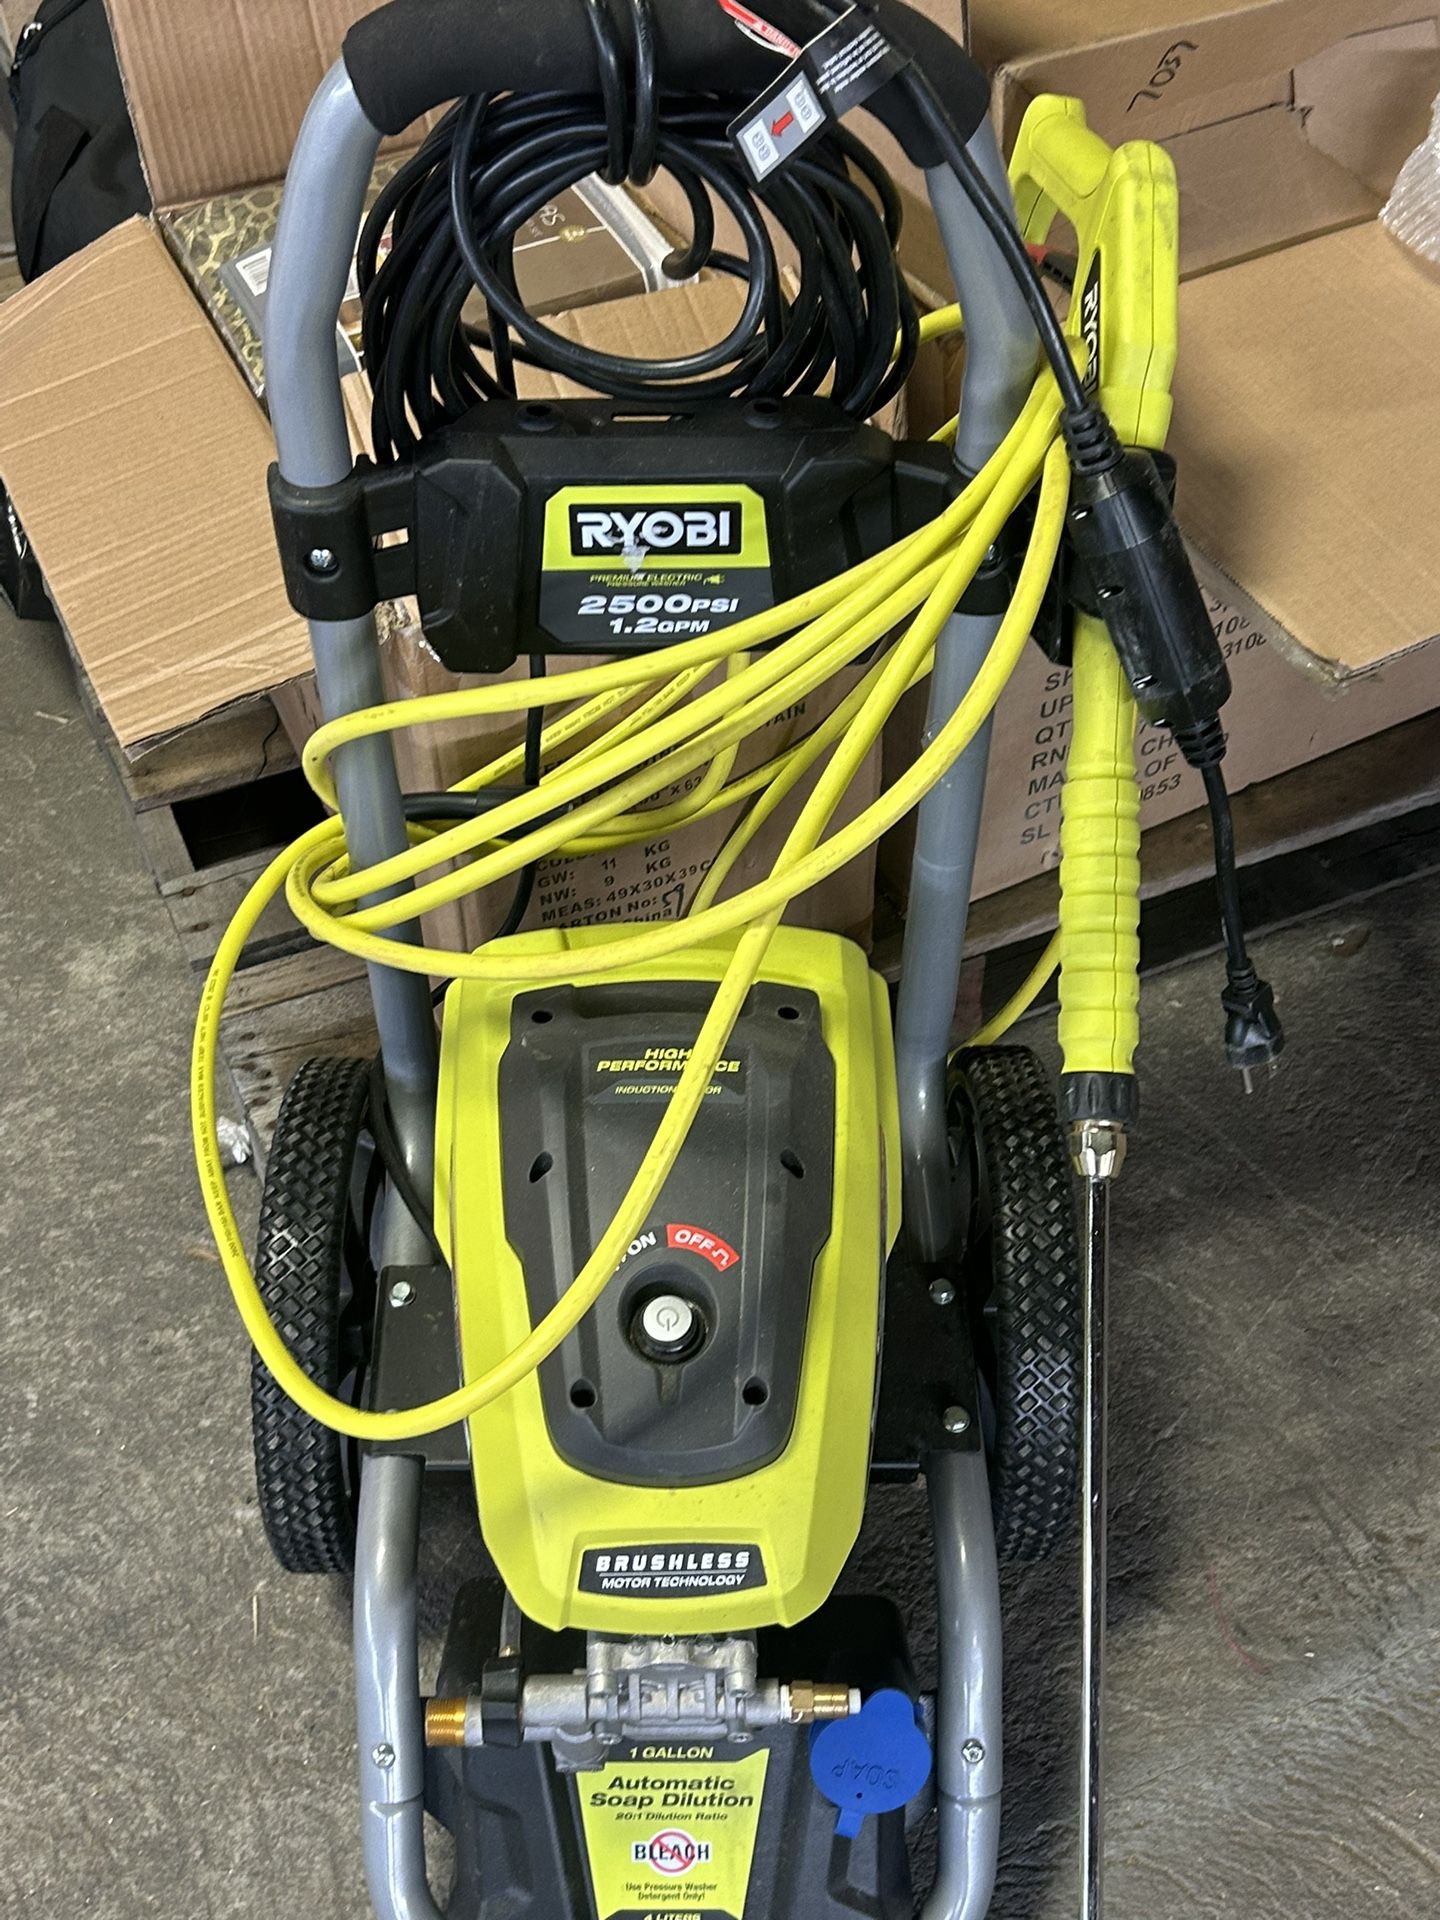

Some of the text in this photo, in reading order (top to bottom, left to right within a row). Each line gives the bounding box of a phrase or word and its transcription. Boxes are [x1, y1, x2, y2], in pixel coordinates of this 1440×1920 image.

[576, 510, 731, 548] RYOBI
[590, 572, 703, 583] PREMIUM ELECTRIC
[578, 594, 739, 615] 2500PSI
[609, 617, 710, 634] 1.2GPM
[1140, 773, 1182, 801] 853
[1024, 793, 1062, 820] CT
[538, 870, 575, 888] GW:
[601, 858, 616, 870] 11
[644, 840, 670, 858] KG
[541, 887, 577, 907] NW:
[645, 857, 672, 874] KG
[542, 898, 602, 922] MEAS:
[559, 896, 657, 928] RTON No:
[644, 1048, 693, 1060] HIGH
[596, 1060, 741, 1073] PERFORMCE
[627, 1229, 716, 1256] ON OFF
[595, 1551, 750, 1573] BRUSHLESS
[602, 1574, 745, 1589] MOTOR TECHNOLOGY
[629, 1746, 714, 1759] 1 GALLON
[607, 1776, 735, 1791] Automatic
[590, 1792, 754, 1809] Soap Dilution
[645, 1811, 692, 1821] Dilution
[695, 1812, 728, 1821] Ratio
[634, 1843, 710, 1861] BLEACH
[644, 1882, 683, 1892] Pressure
[685, 1882, 718, 1891] Washer
